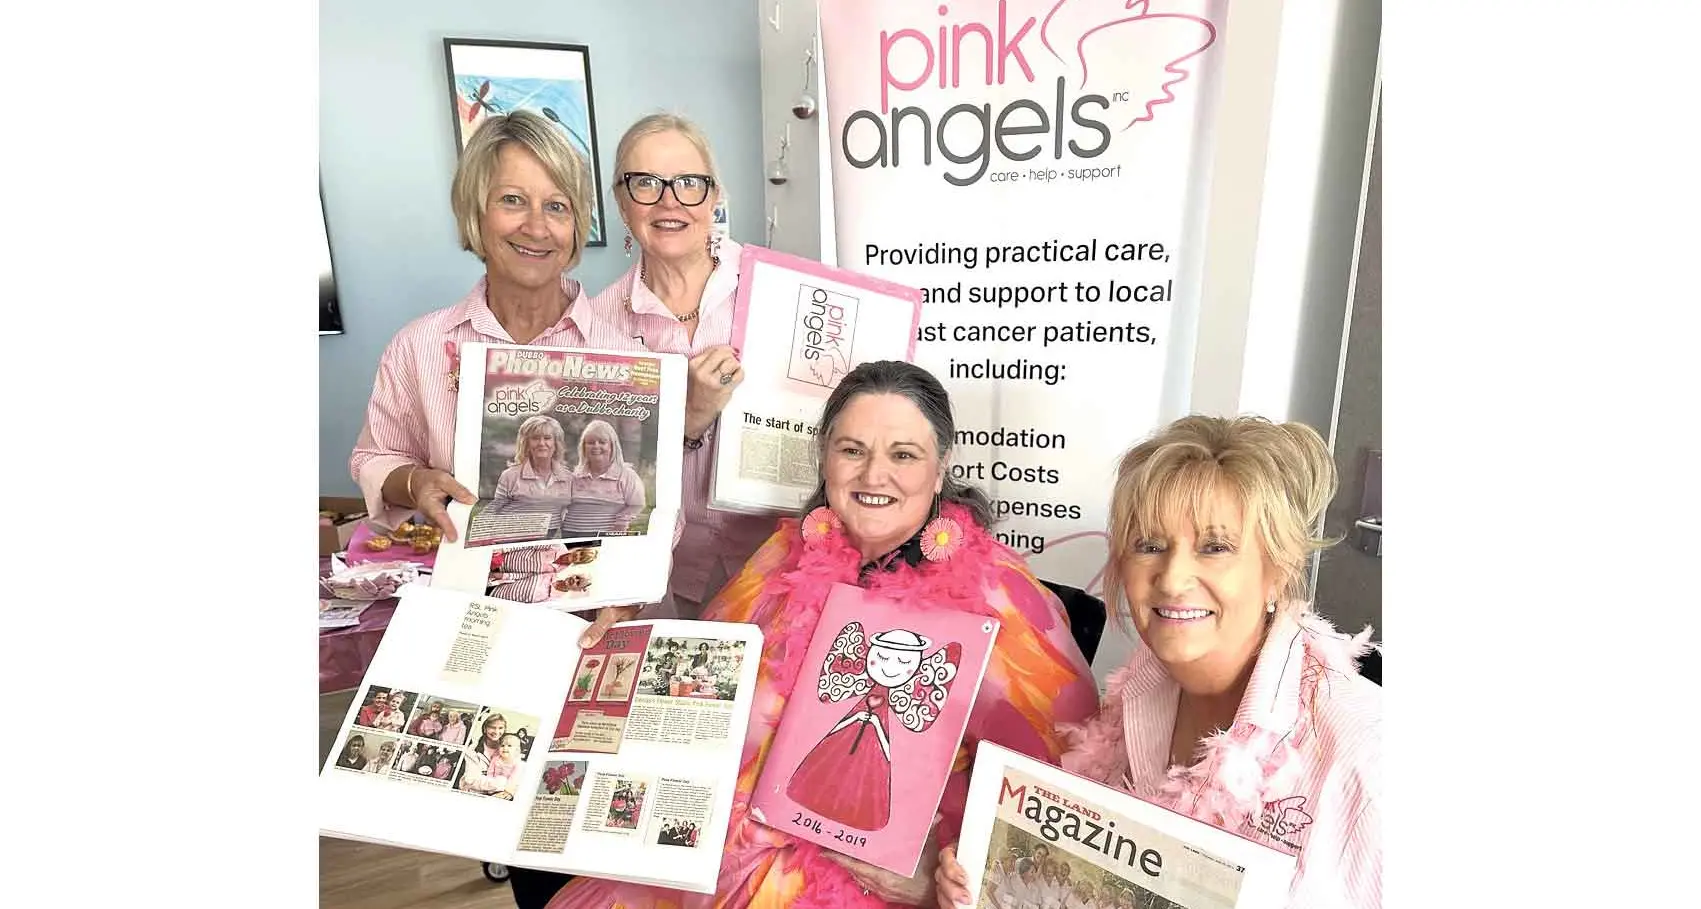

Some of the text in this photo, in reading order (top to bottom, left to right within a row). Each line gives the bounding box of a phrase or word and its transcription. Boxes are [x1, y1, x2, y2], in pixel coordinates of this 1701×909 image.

[880, 0, 1036, 115] pink
[842, 76, 1111, 186] angels
[990, 164, 1121, 183] care help support
[865, 239, 1171, 269] Providing practical care,
[920, 280, 1173, 308] and support to local
[804, 288, 827, 361] angels
[826, 303, 848, 348] pink
[953, 324, 1036, 343] cancer
[1044, 320, 1157, 347] patients,
[949, 358, 1066, 385] including:
[496, 385, 525, 402] pink
[558, 386, 617, 404] Celebrating
[487, 399, 539, 416] angels
[612, 404, 651, 421] charity
[743, 412, 761, 425] The
[766, 417, 790, 431] start
[794, 422, 804, 433] of
[991, 461, 1060, 484] Costs
[1034, 785, 1102, 821] THE LAND
[792, 812, 822, 835] 2016
[834, 829, 867, 847] 2019
[998, 776, 1163, 878] Magazine
[1236, 865, 1246, 874] 37
